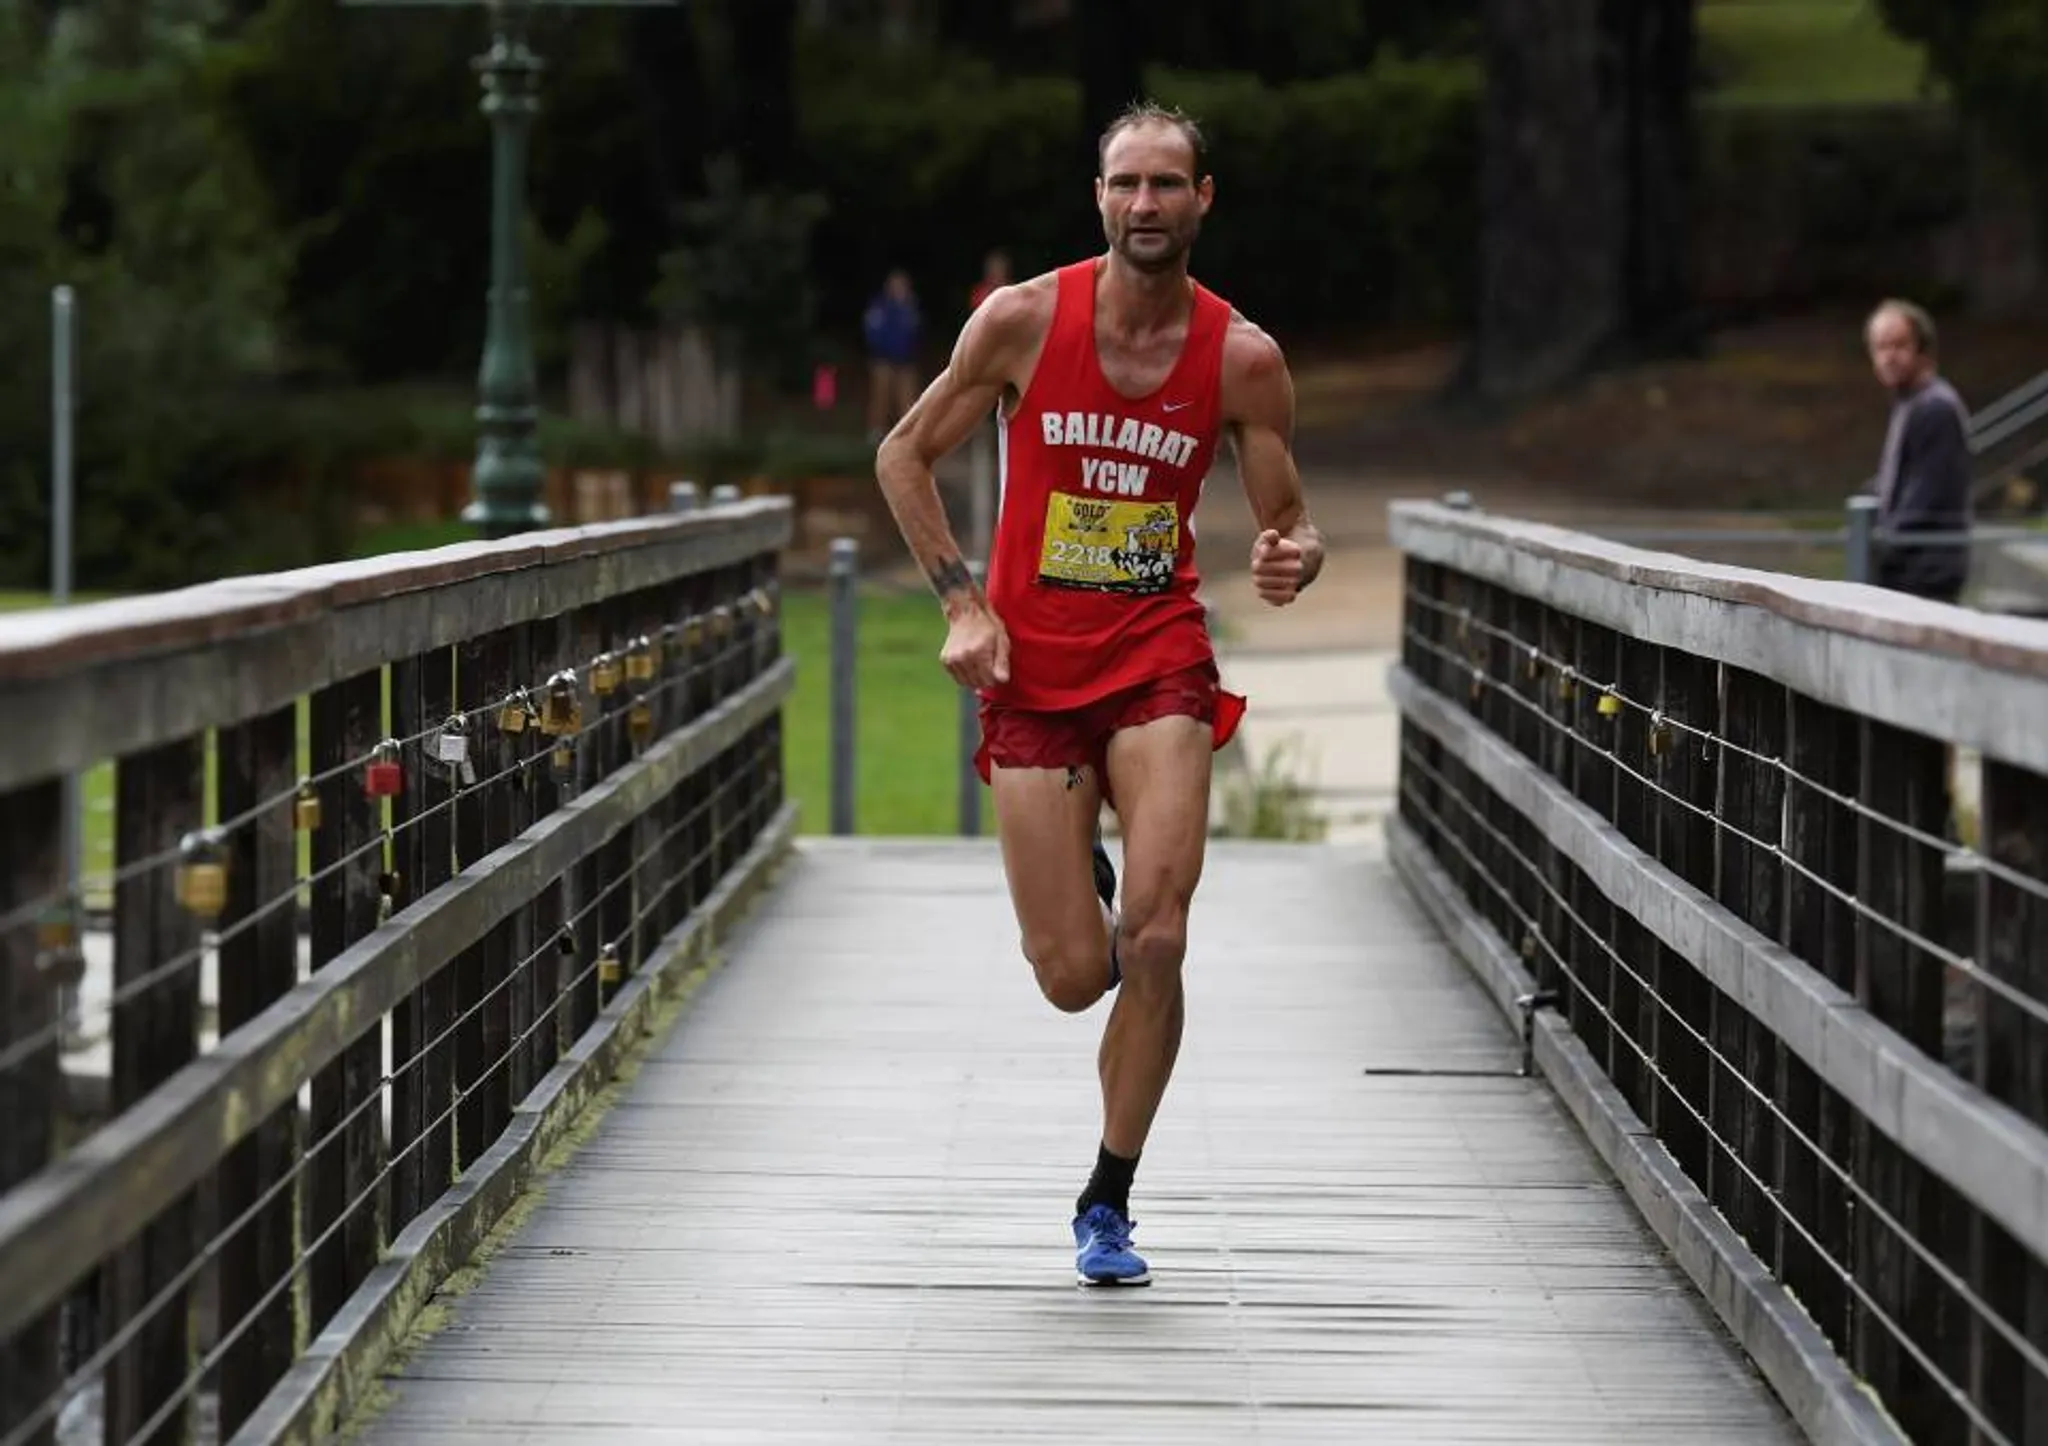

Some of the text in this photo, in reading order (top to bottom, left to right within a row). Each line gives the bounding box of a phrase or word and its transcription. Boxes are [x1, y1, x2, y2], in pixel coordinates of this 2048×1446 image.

[1041, 412, 1198, 467] BALLARAT
[1081, 457, 1149, 496] YCW
[1050, 540, 1111, 566] 2218
